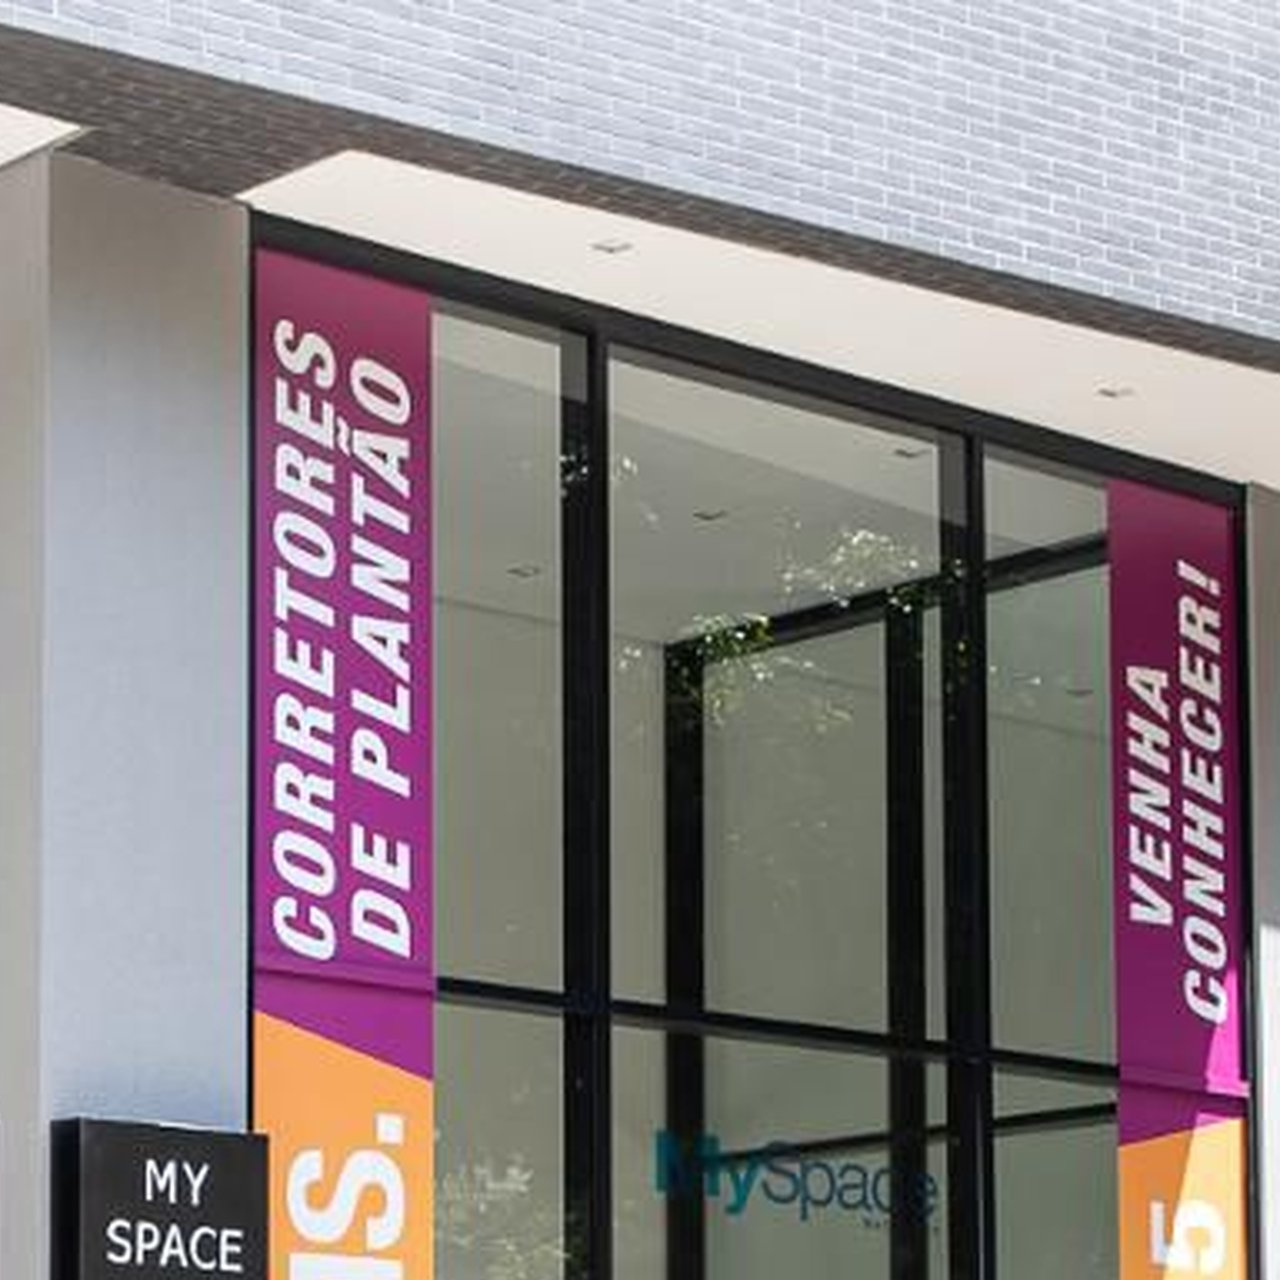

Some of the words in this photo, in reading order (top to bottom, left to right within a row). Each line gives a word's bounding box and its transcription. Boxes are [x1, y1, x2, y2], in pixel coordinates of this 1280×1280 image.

[273, 319, 337, 961] CORRETORES
[336, 356, 411, 802] PLANTÃO
[351, 822, 411, 958] DE
[1126, 665, 1173, 927] VENHA
[1177, 559, 1228, 1025] CONHECER!
[105, 1218, 244, 1273] SPACE
[144, 1158, 210, 1206] MY
